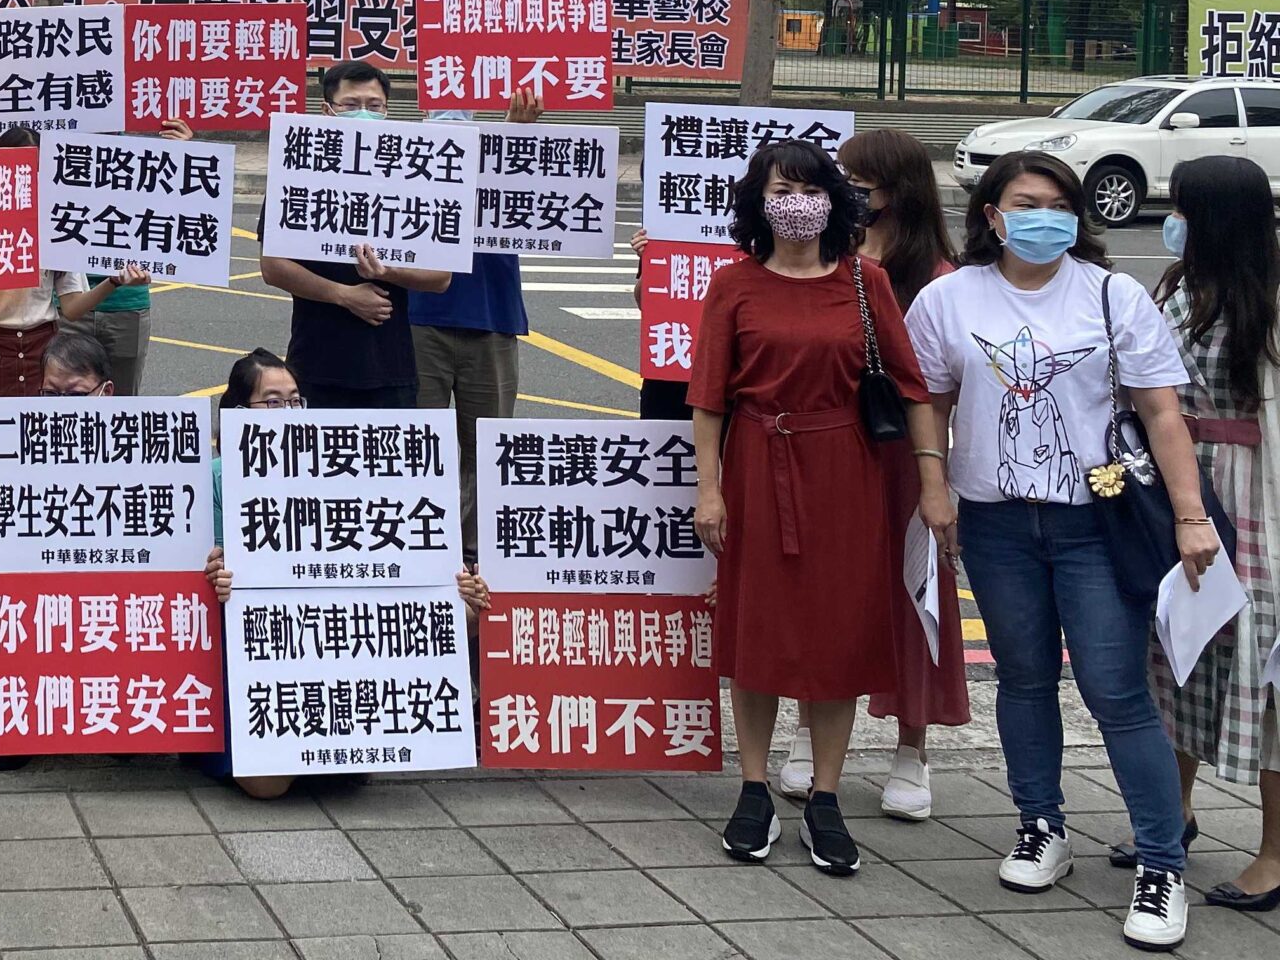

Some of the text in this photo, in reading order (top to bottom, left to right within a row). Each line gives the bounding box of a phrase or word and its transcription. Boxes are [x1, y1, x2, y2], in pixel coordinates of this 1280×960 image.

[131, 18, 301, 62] 你們要輕軌
[1200, 8, 1280, 78] 拒絕
[131, 75, 300, 120] 我們要安全
[423, 55, 608, 100] 我們不要
[52, 143, 222, 199] 還路於民
[282, 125, 466, 185] 維護上學安全
[50, 201, 220, 257] 安全有感
[279, 185, 462, 245] 還我通行步道
[700, 225, 735, 239] 中華
[473, 235, 563, 252] 中華藝校家長會
[648, 253, 746, 302] 二階段
[238, 423, 444, 478] 你們要輕軌
[495, 433, 699, 488] 禮讓安全
[240, 496, 448, 553] 我們要安全
[495, 505, 705, 559] 輕軌改道
[41, 548, 151, 565] 中華藝校家長會
[292, 563, 401, 580] 中華藝校家長會
[546, 569, 655, 586] 中華藝校家長會
[242, 601, 457, 662] 輕軌汽車共用路權
[487, 607, 713, 669] 二階段輕軌與民爭道
[247, 677, 462, 739] 家長憂慮學生安全
[488, 694, 714, 758] 我們不要
[300, 746, 412, 766] 中華藝校家長會
